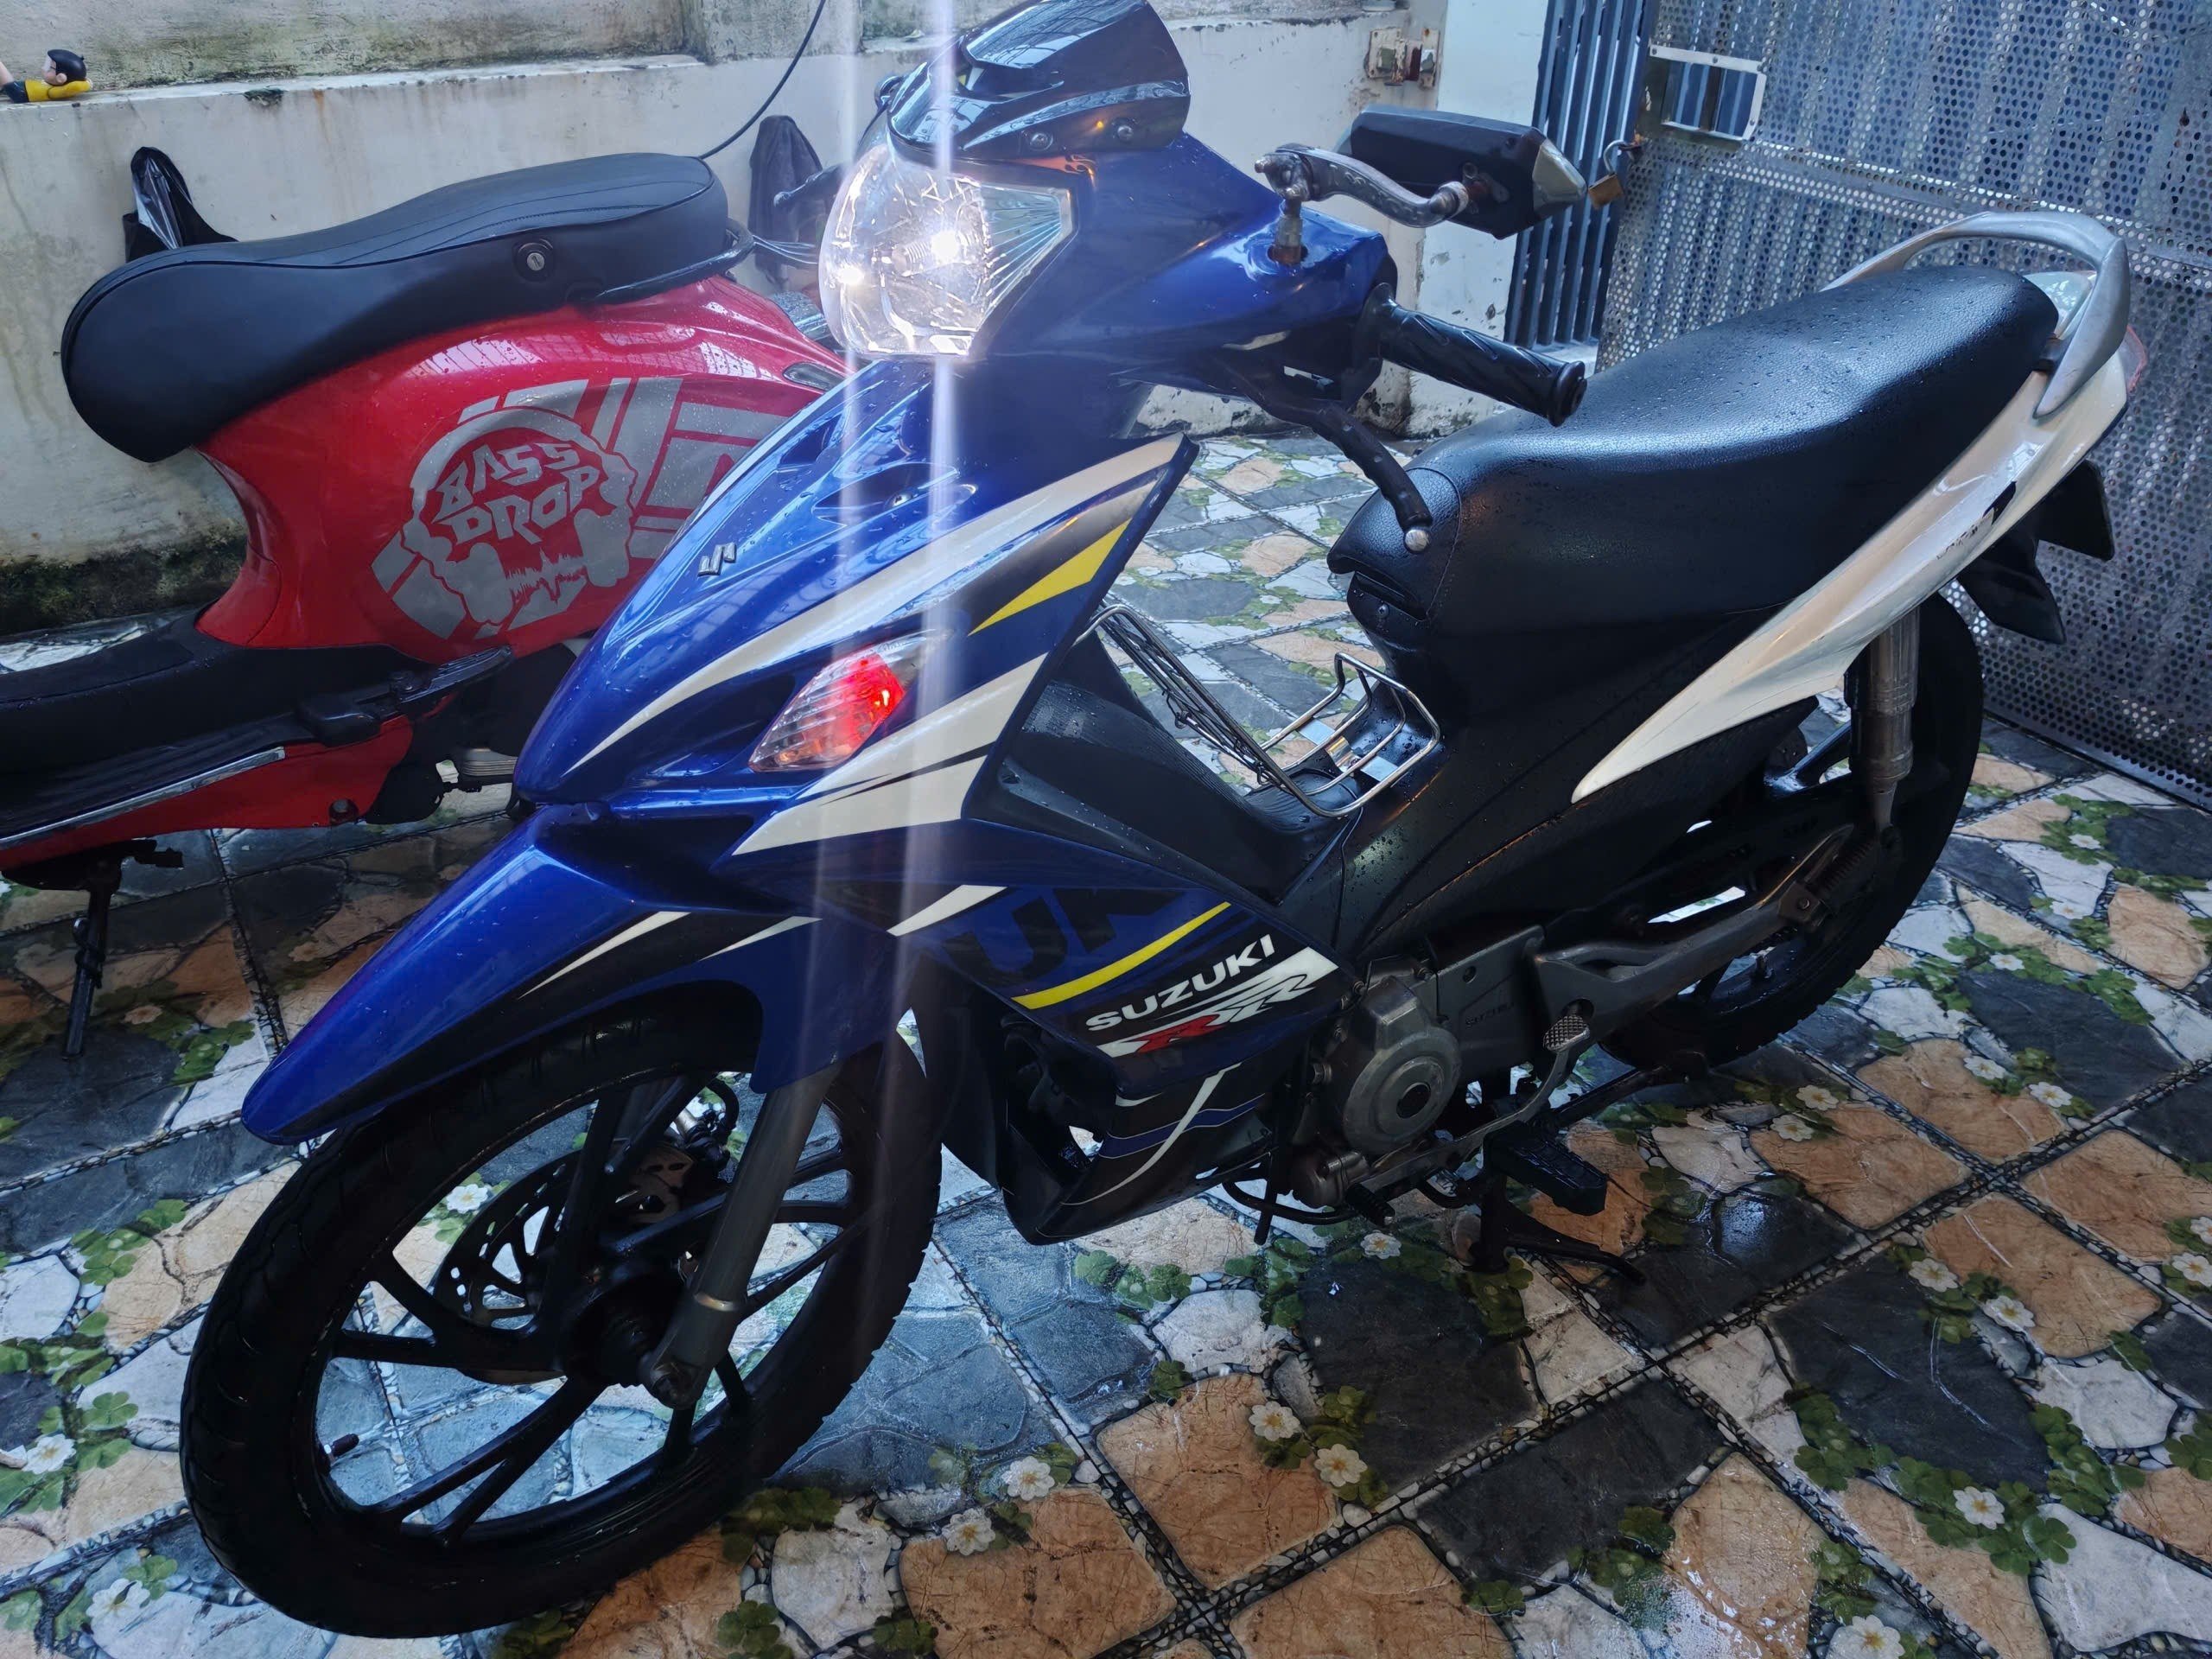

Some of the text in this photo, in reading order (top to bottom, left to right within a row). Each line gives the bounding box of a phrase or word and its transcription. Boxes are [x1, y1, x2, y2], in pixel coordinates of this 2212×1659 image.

[434, 444, 582, 524] BASS
[444, 465, 601, 543] DROP
[1085, 934, 1276, 1032] SUZUKI
